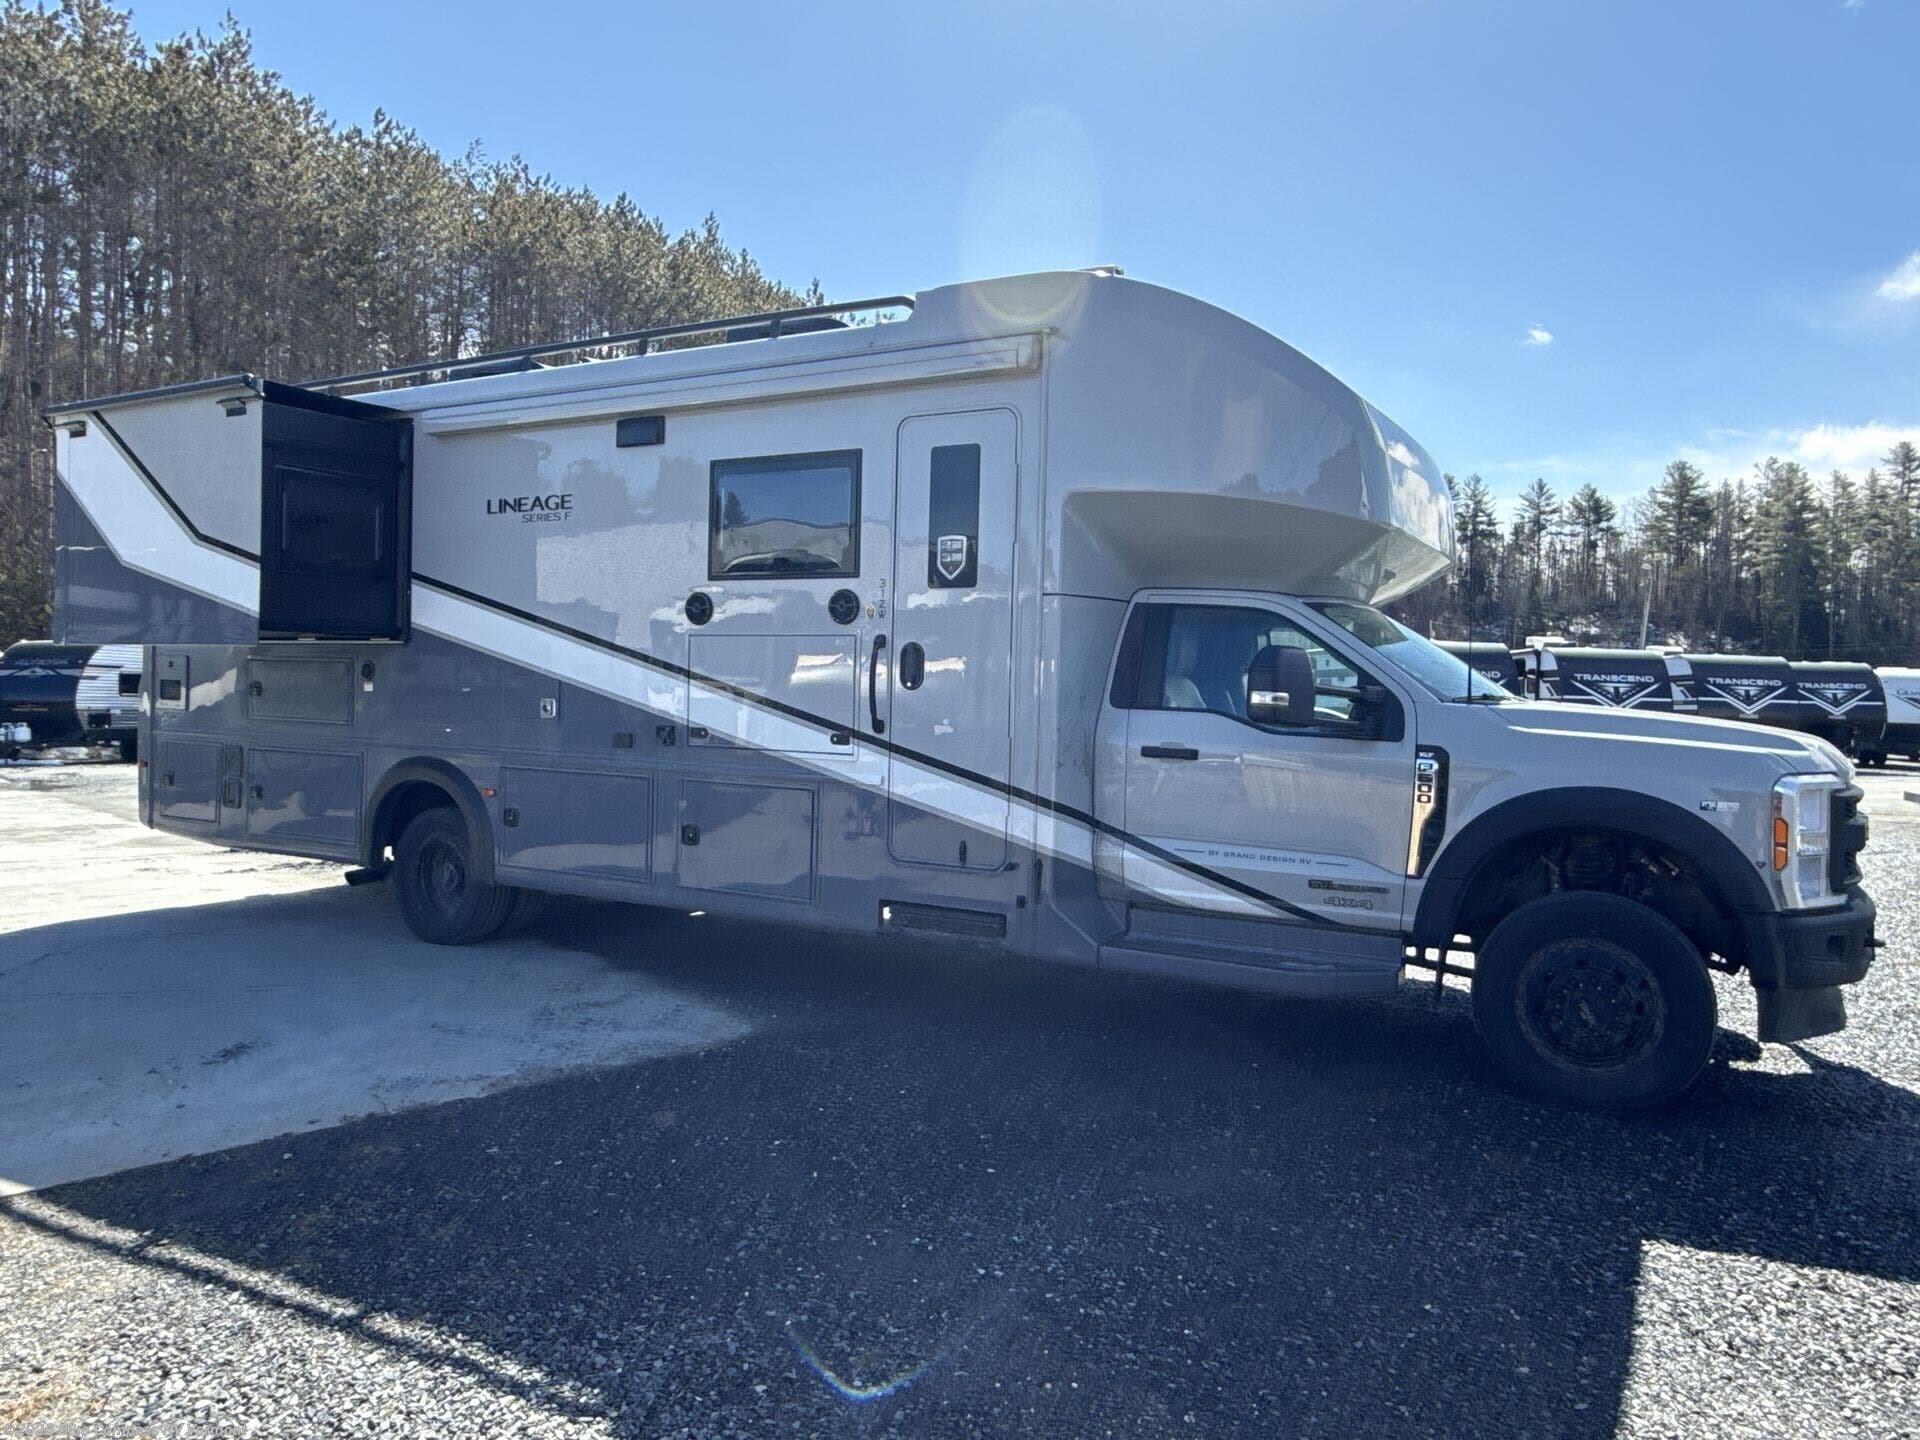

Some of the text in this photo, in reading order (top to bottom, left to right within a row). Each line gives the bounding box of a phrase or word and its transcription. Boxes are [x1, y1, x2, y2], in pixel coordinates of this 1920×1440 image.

[487, 494, 573, 514] LINEAGE
[522, 511, 572, 523] SERIES F
[1574, 673, 1655, 683] TRANSCEND
[1707, 677, 1782, 687] TRANSCEND
[1223, 851, 1256, 860] GRAND
[1259, 854, 1296, 864] DESIGN
